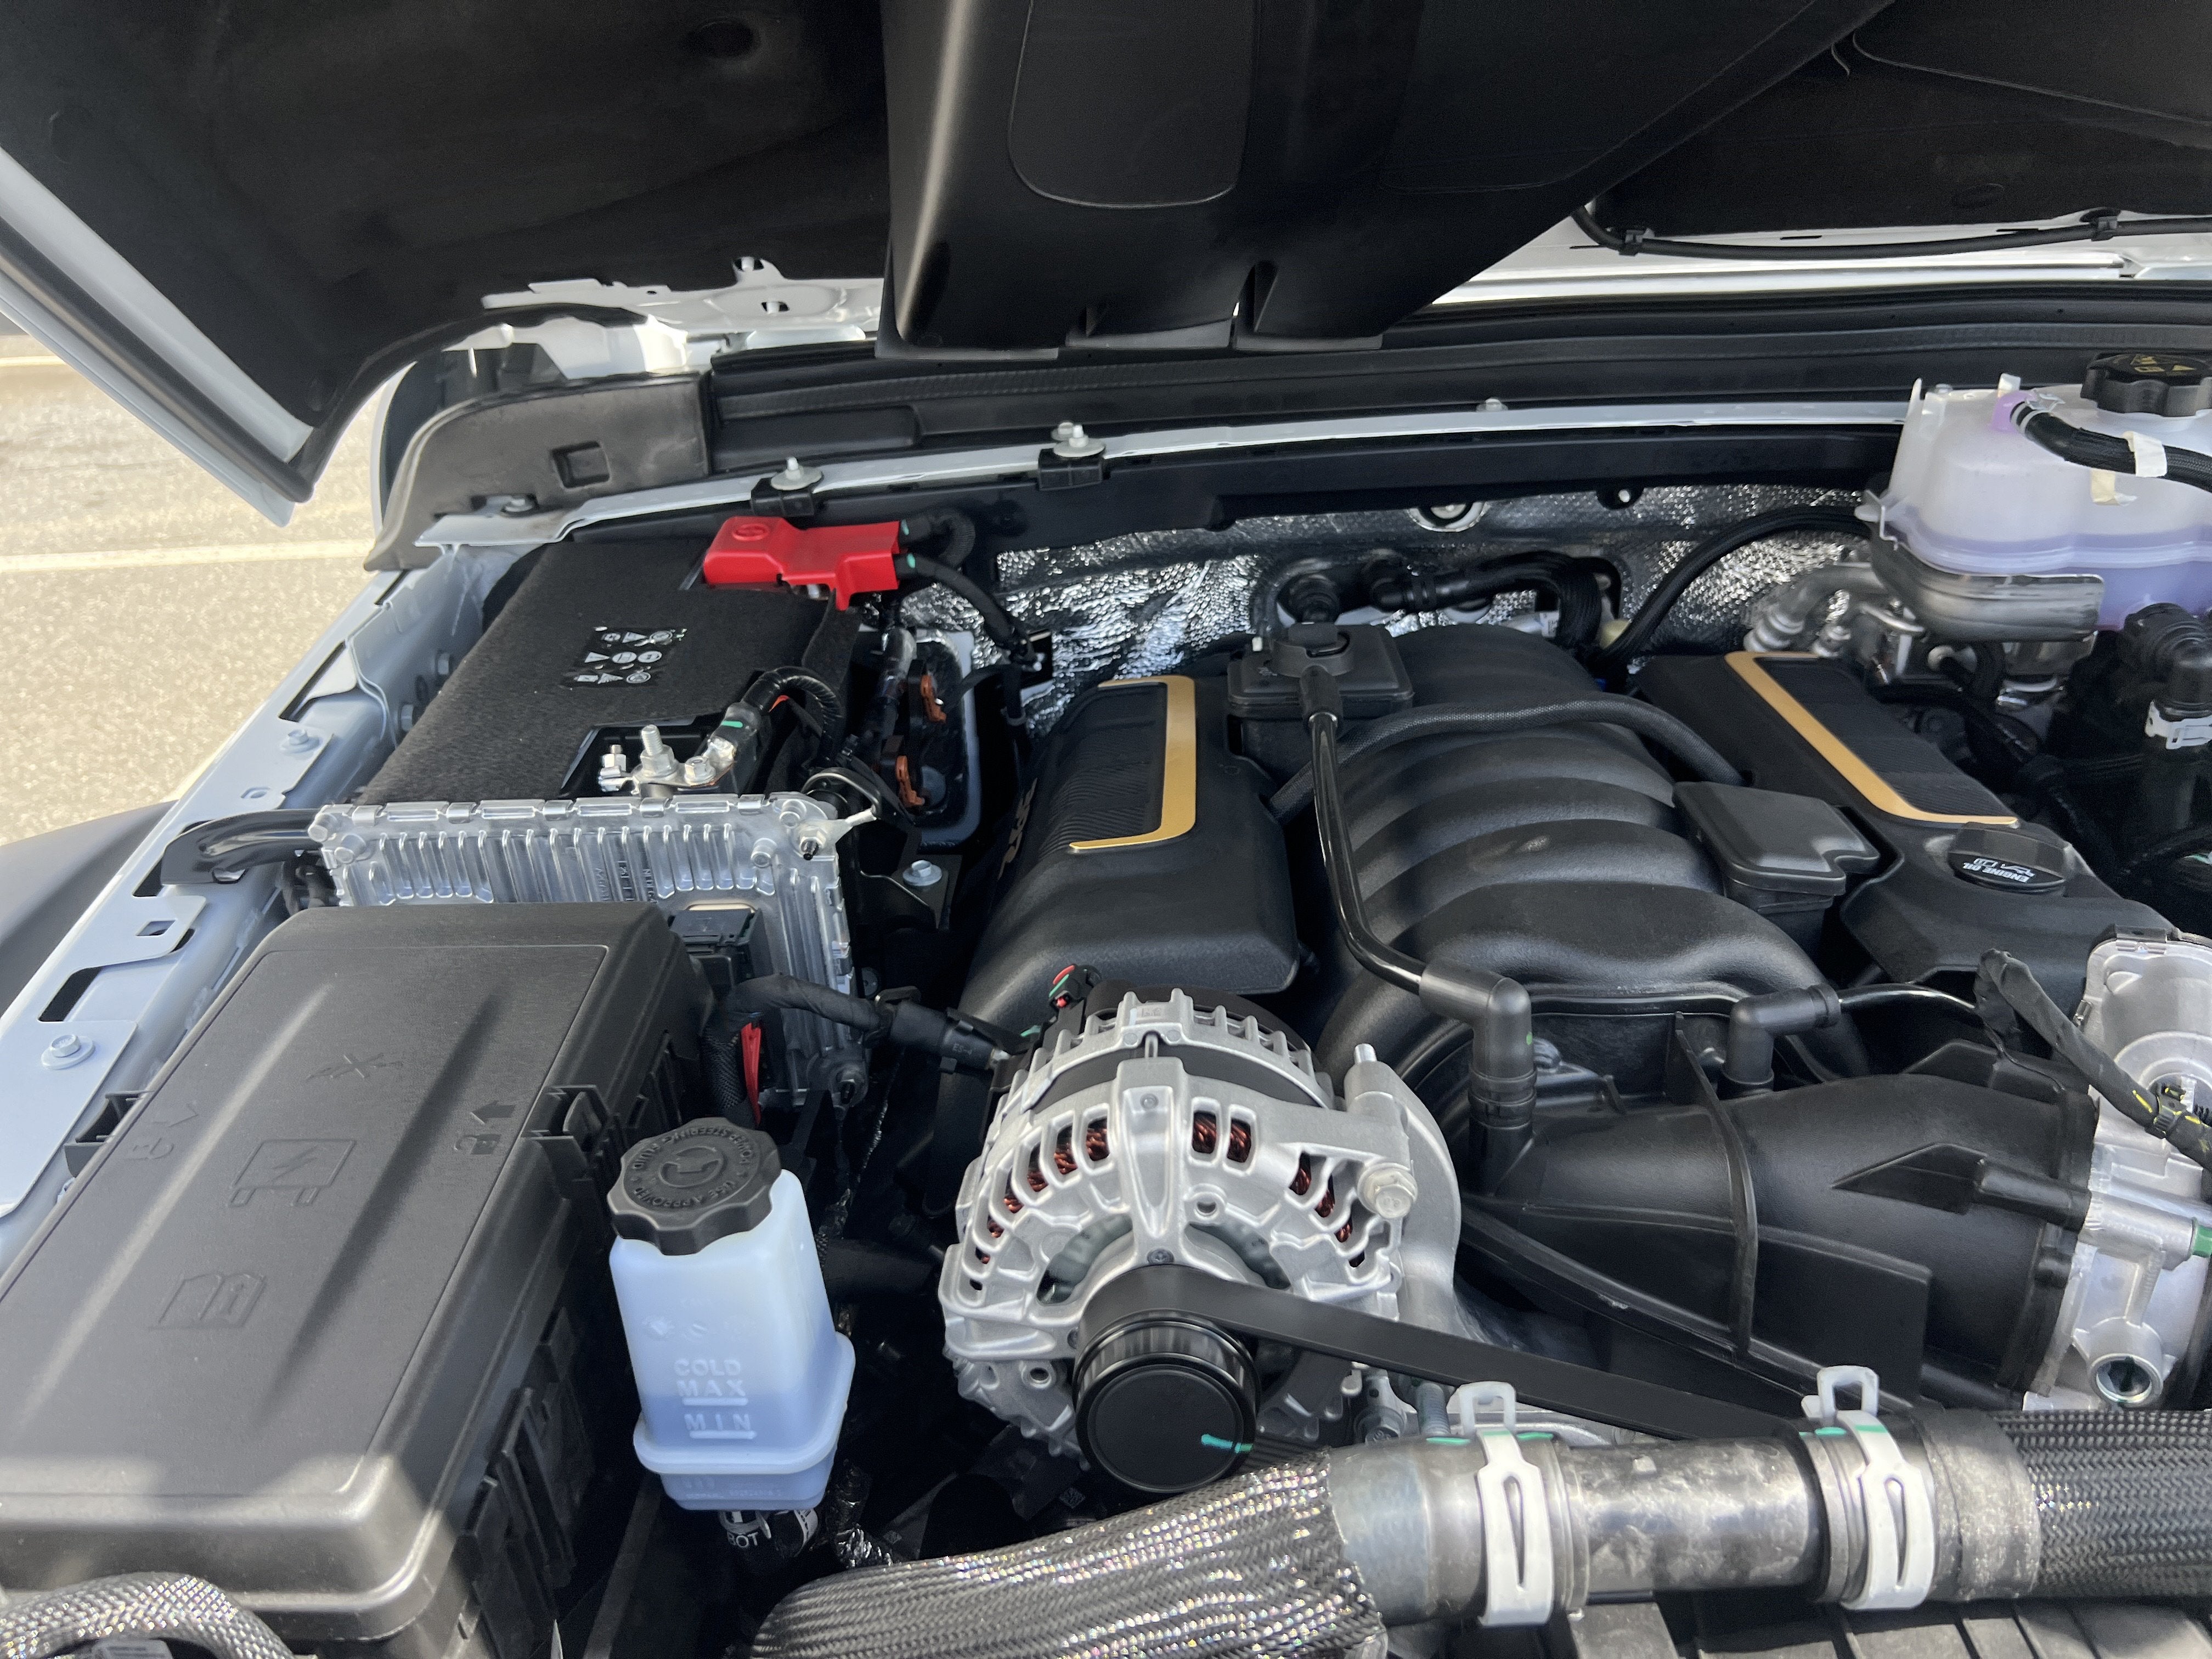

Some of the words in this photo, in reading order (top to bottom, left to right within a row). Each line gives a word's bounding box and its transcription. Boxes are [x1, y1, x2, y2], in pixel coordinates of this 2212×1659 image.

[1962, 862, 1982, 871] OIL
[1982, 867, 2030, 883] ENGINE
[662, 1127, 733, 1144] STEERING
[633, 1143, 659, 1169] FLUID
[729, 1133, 753, 1165] POWER
[633, 1187, 707, 1207] APPROVED
[708, 1181, 736, 1197] USE
[674, 1358, 741, 1376] COLD
[676, 1379, 746, 1397] MAX
[684, 1413, 751, 1431] MIN
